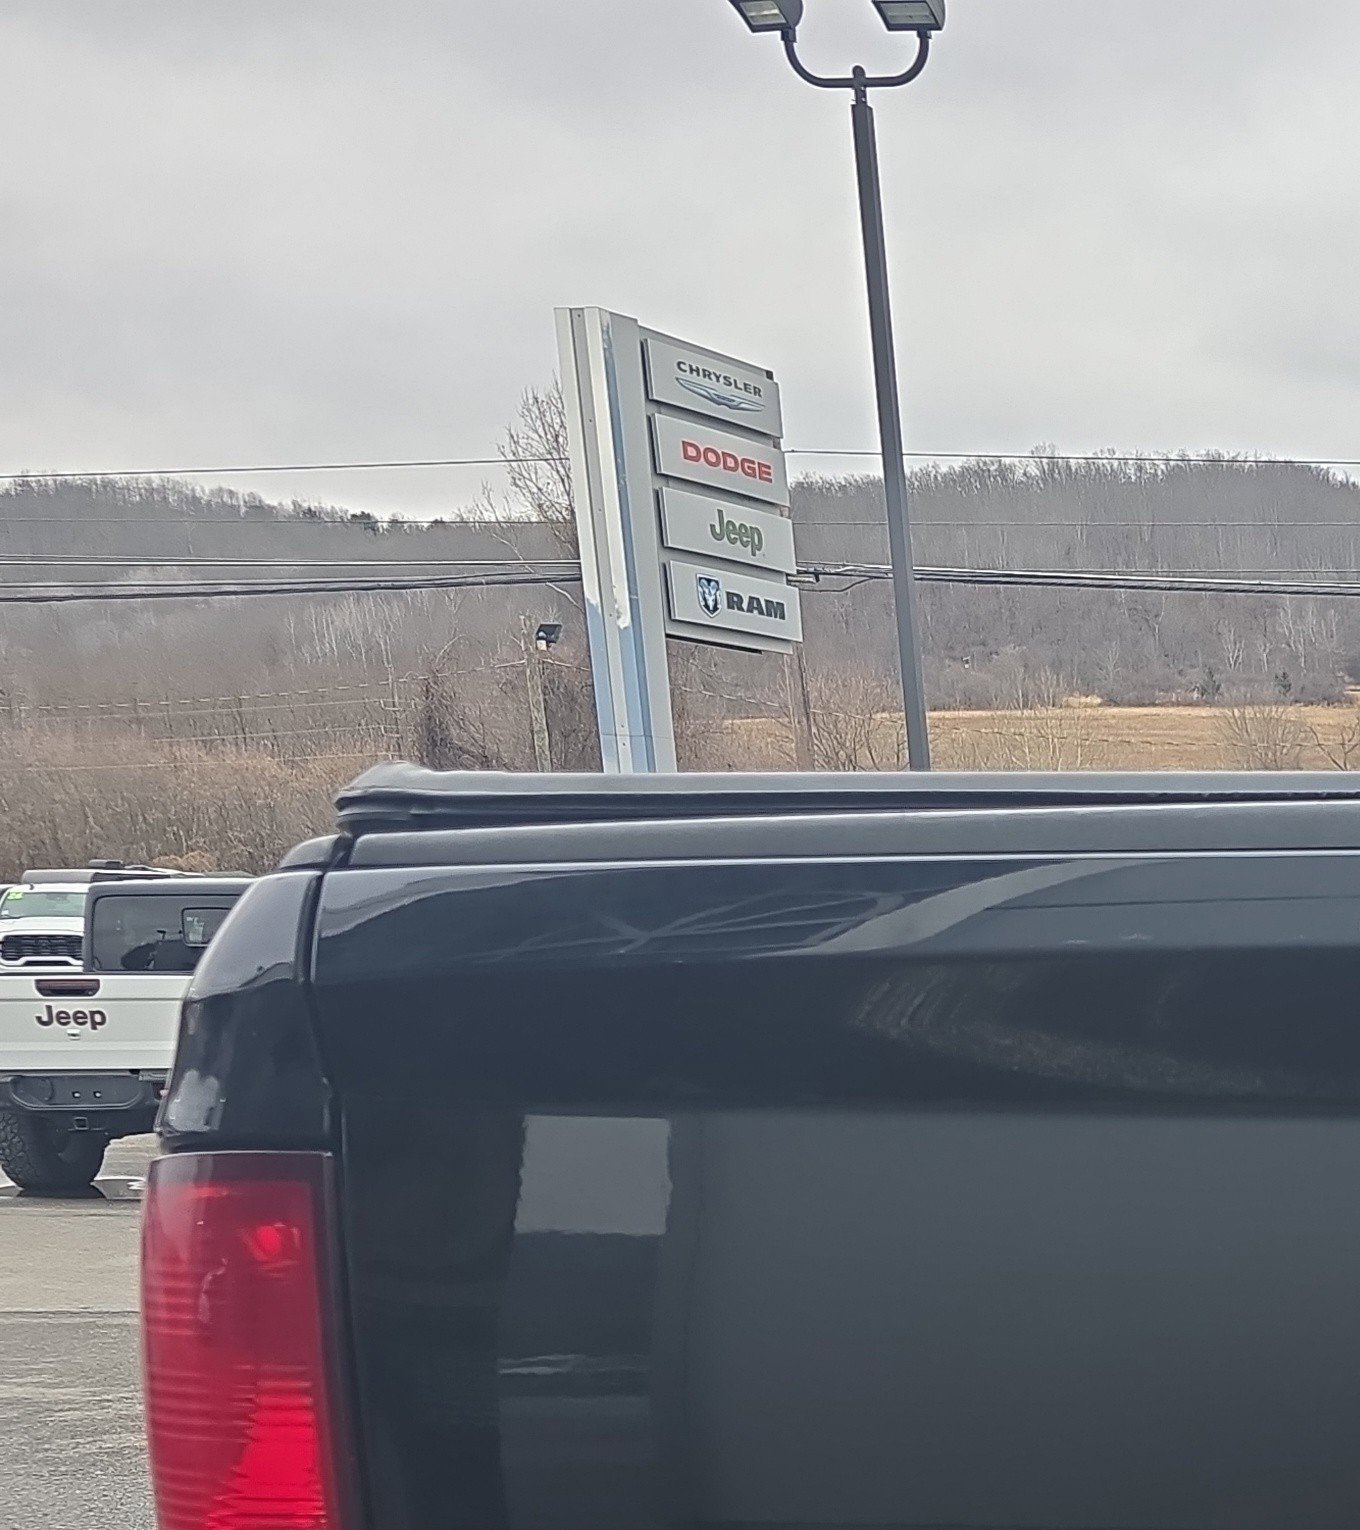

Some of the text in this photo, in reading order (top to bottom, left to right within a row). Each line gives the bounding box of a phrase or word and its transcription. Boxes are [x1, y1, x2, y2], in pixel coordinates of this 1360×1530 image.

[676, 360, 763, 398] CHRYSLER
[681, 439, 773, 483] DODGE
[709, 508, 764, 556] Jeep
[725, 590, 786, 621] RAM
[35, 1004, 107, 1030] Jeep
